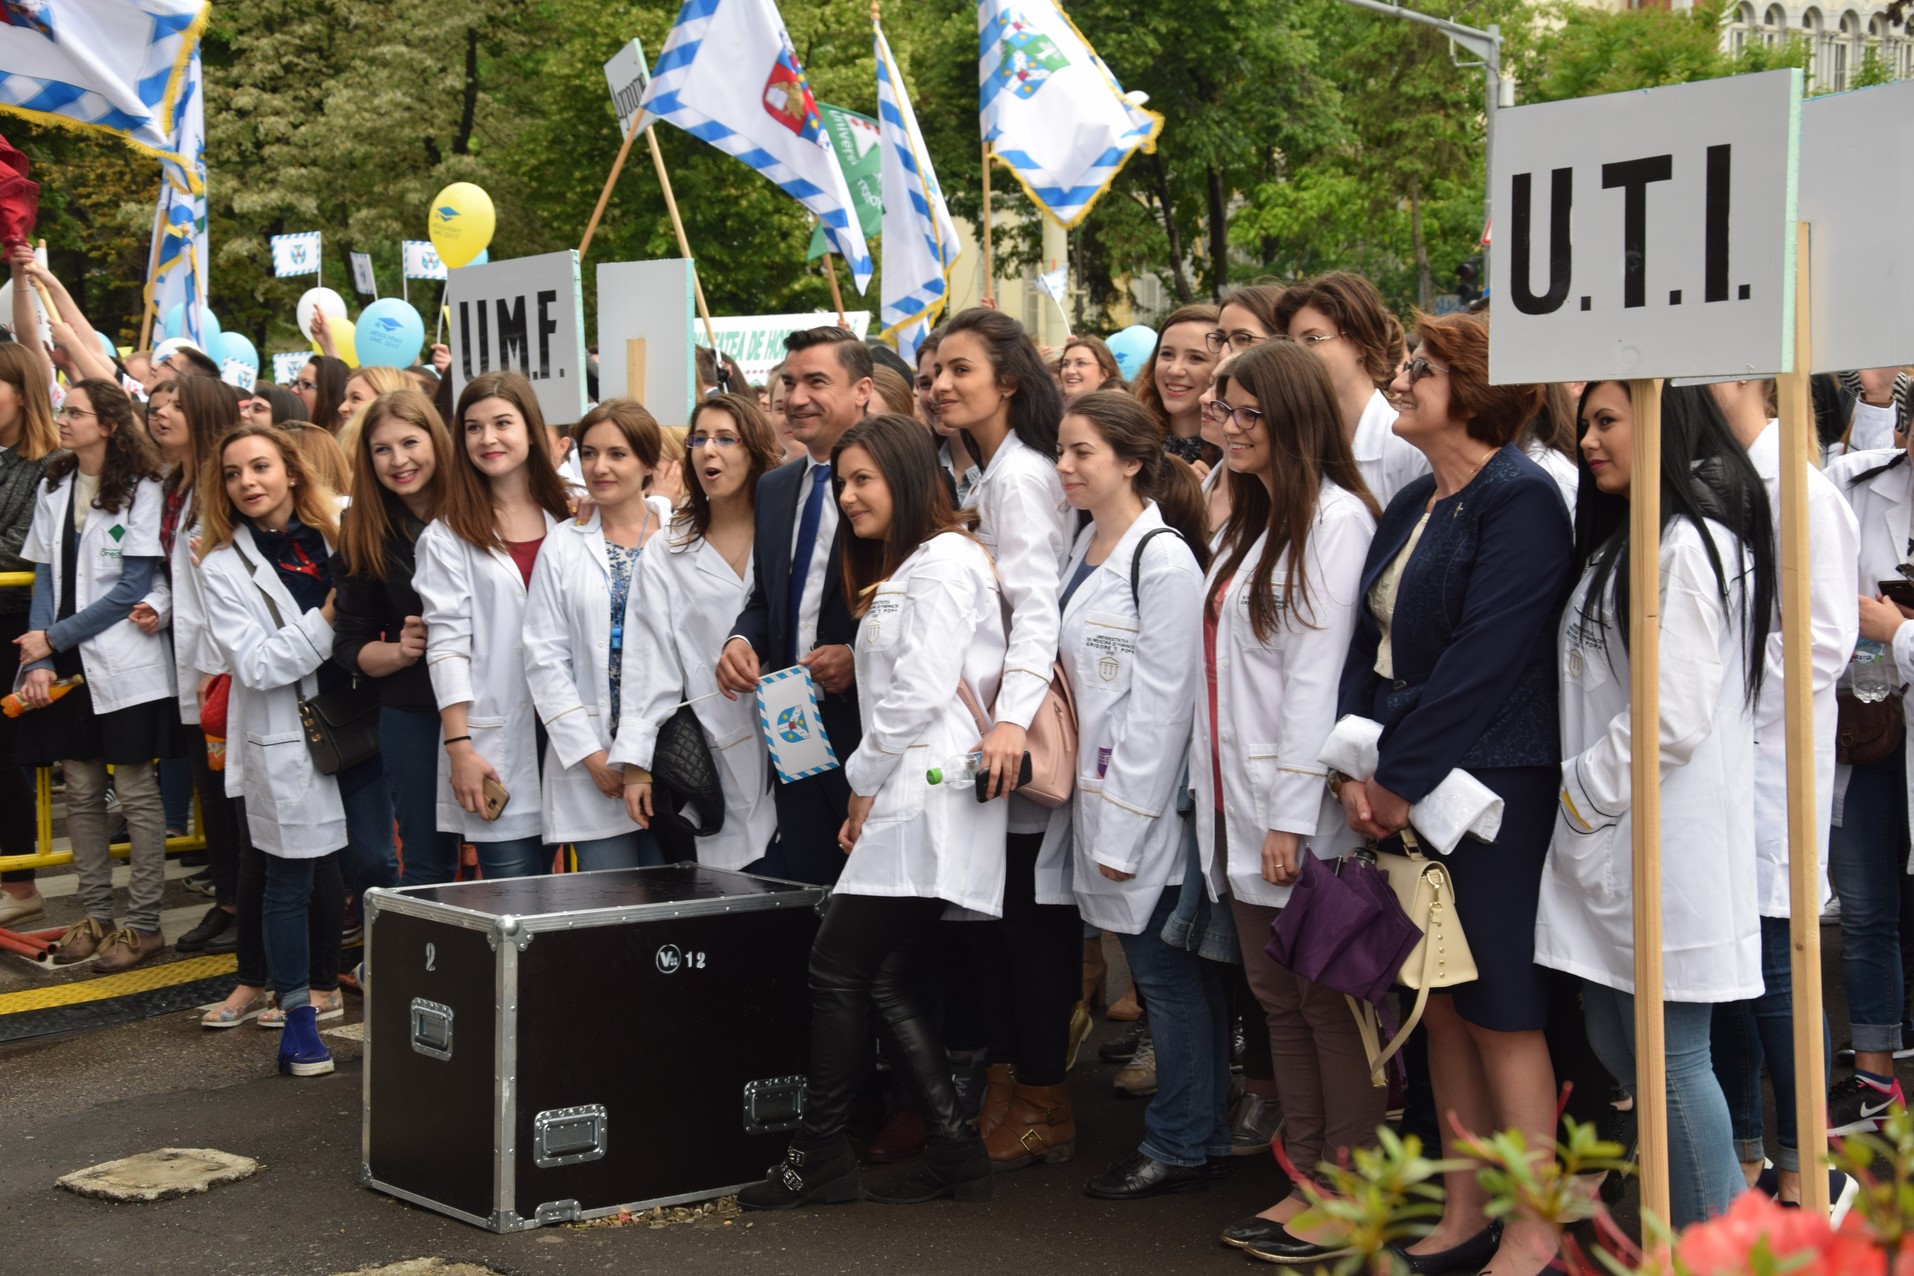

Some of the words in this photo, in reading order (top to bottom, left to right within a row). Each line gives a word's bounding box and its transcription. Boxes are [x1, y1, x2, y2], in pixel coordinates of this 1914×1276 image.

[1510, 143, 1751, 316] U.T.I.
[745, 329, 766, 361] DE
[1086, 641, 1111, 650] GRIGORE
[426, 942, 436, 972] 2
